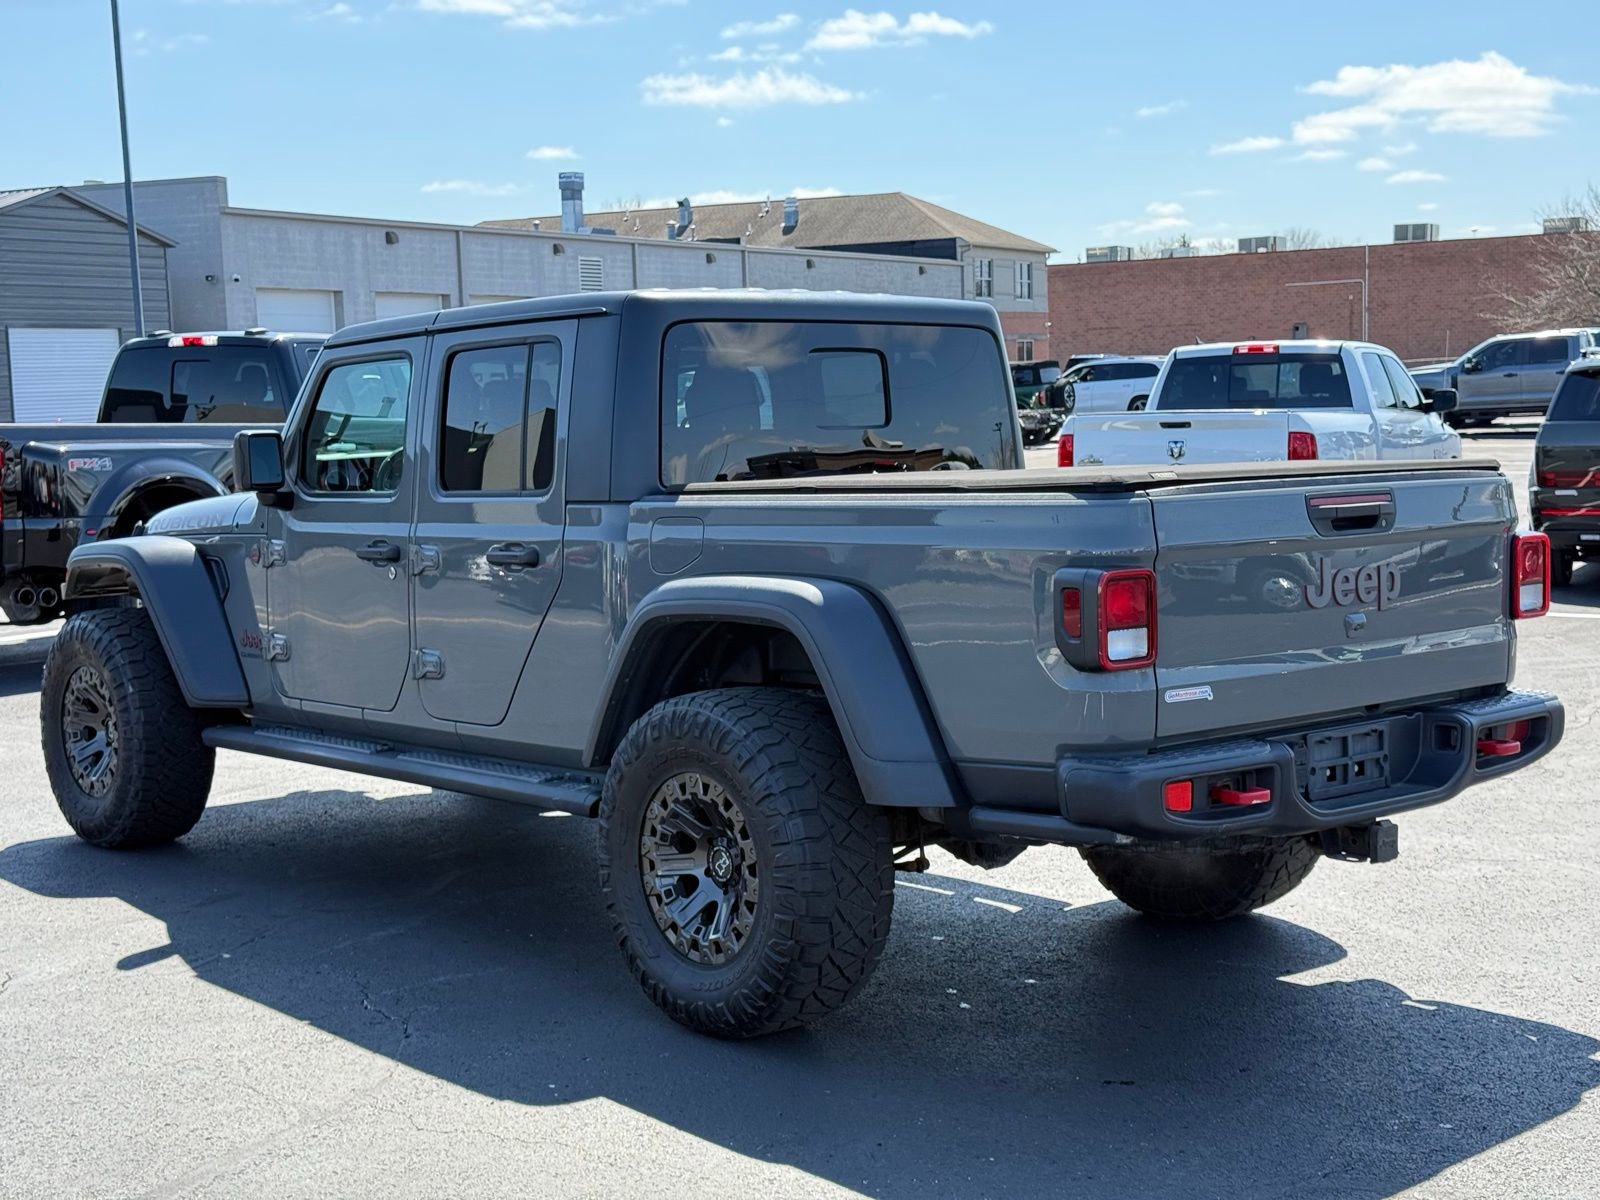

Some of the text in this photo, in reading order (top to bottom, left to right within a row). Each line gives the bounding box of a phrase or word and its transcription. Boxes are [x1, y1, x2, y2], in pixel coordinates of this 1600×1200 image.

[68, 457, 113, 472] FX4
[149, 514, 225, 532] RUBICON
[1304, 554, 1401, 612] Jeep
